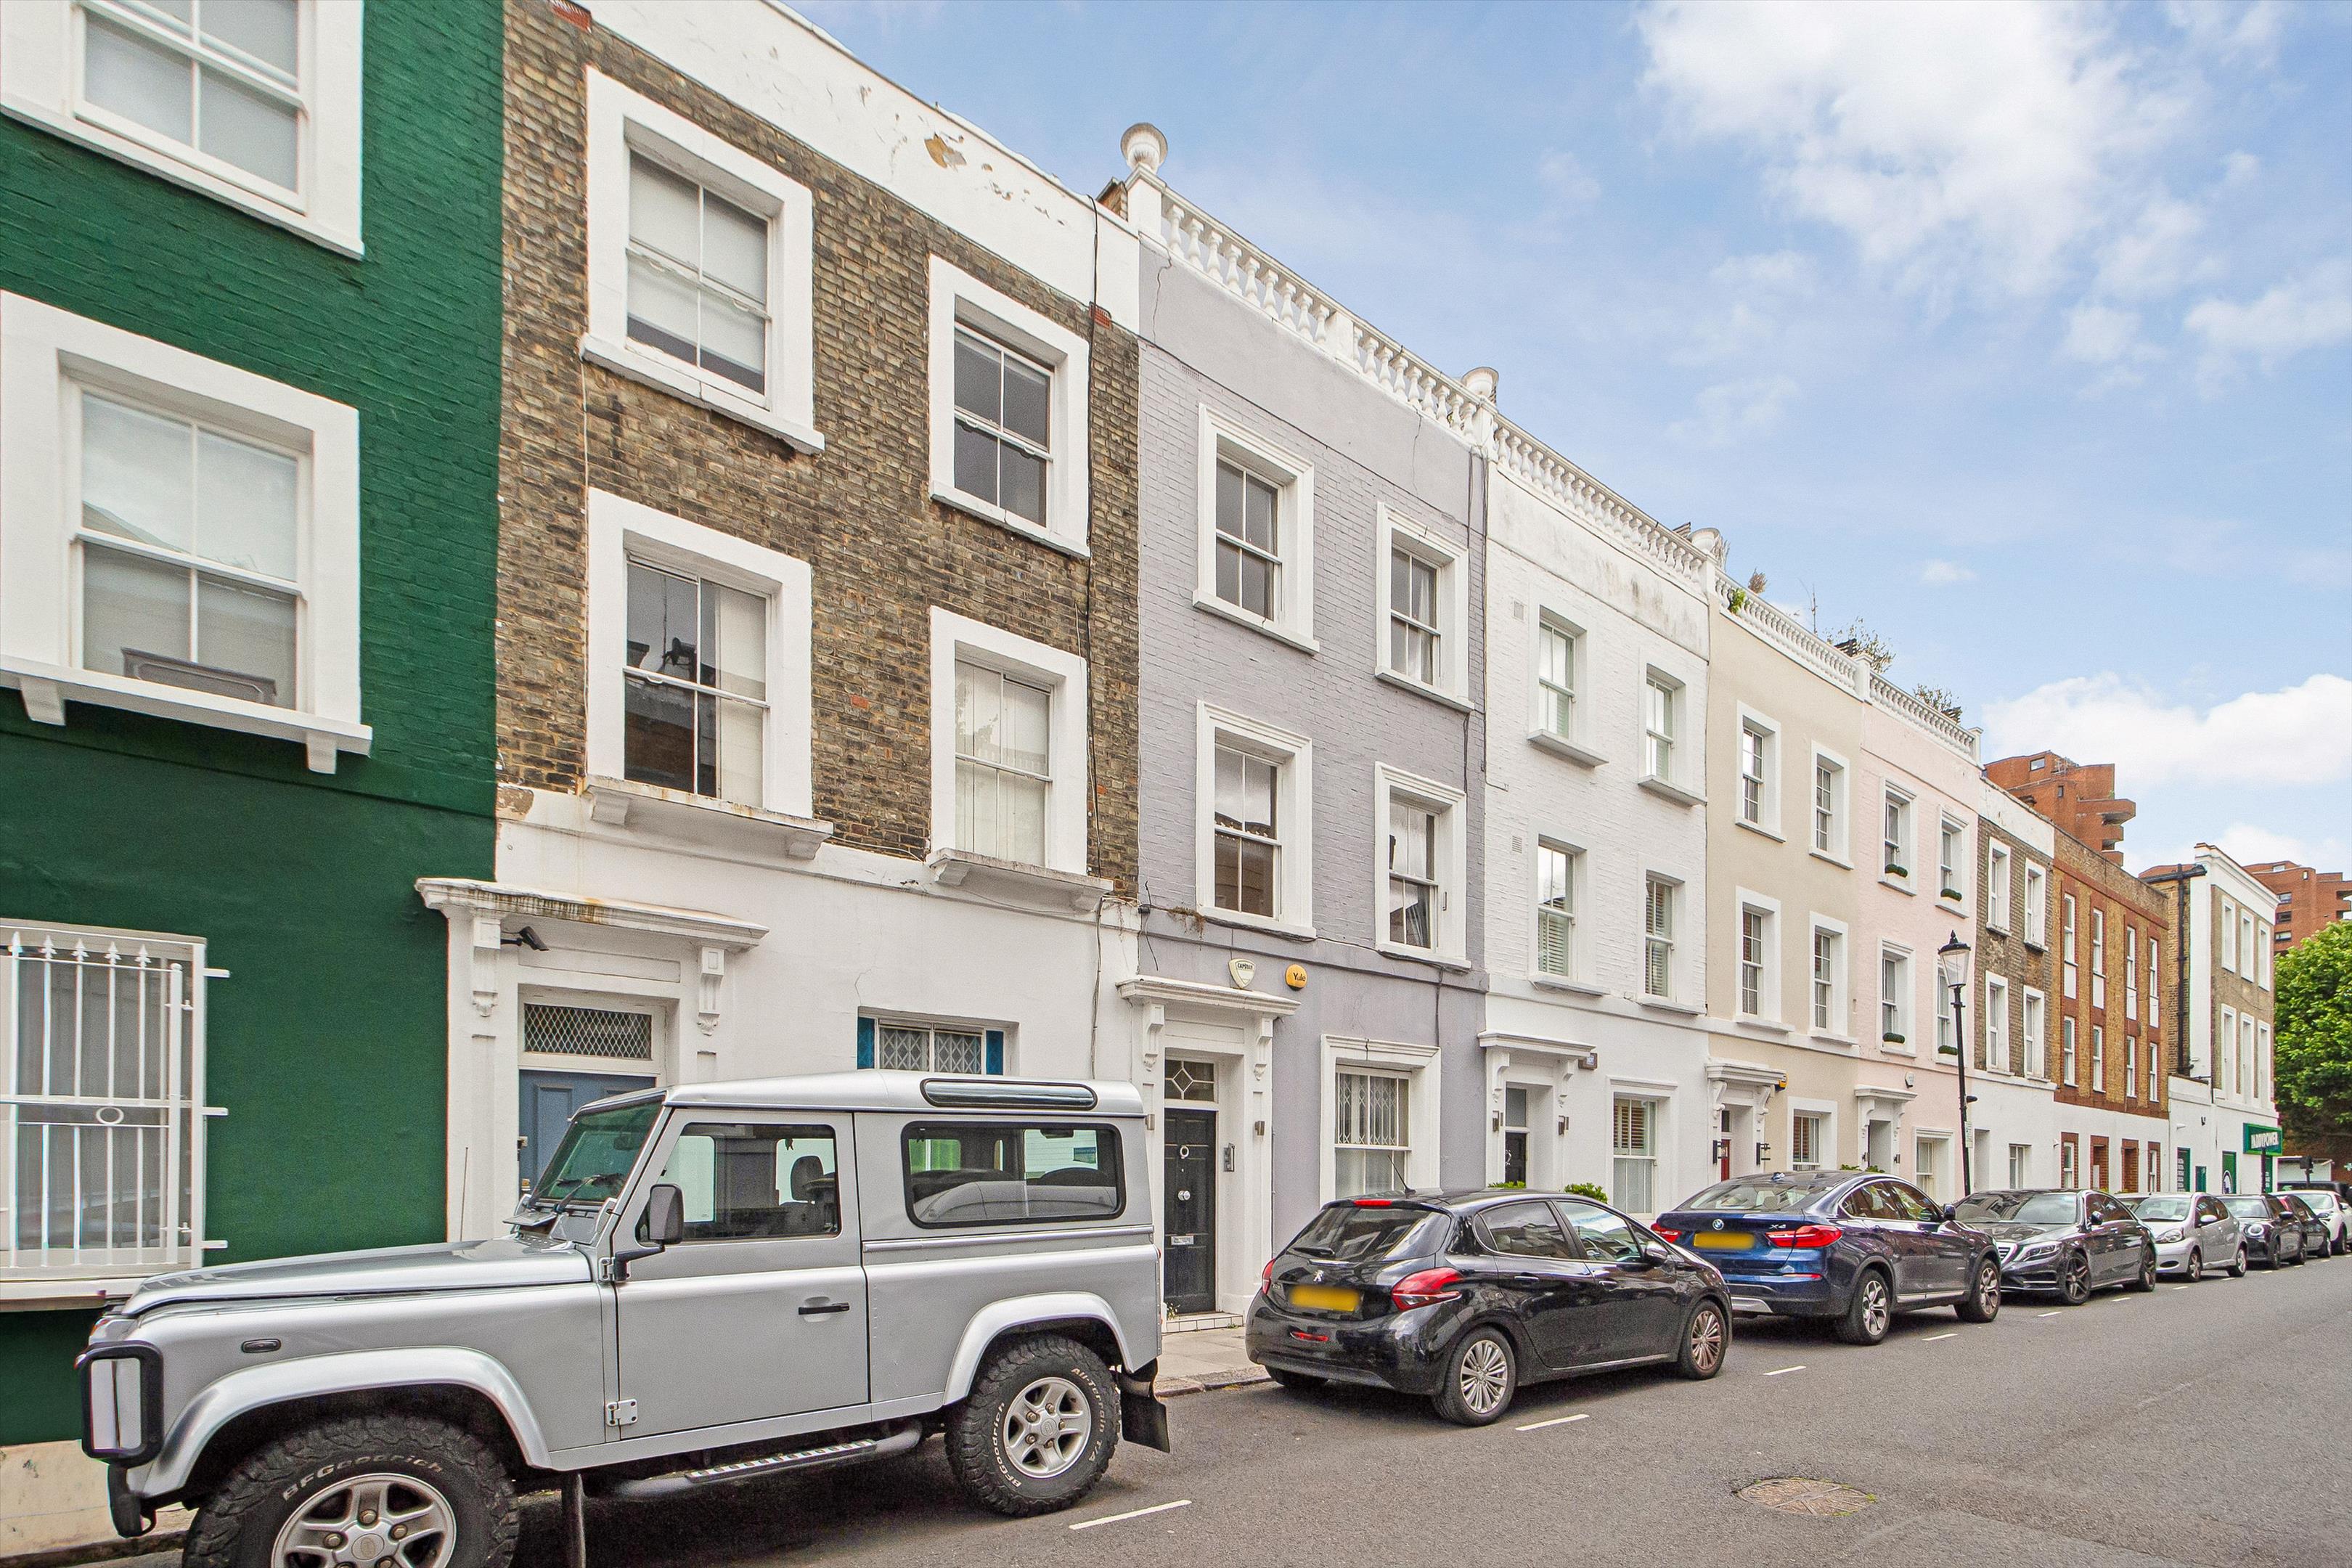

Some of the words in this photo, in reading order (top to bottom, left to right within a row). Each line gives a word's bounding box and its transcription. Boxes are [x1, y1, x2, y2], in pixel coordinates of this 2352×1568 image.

[1293, 972, 1306, 982] Yale
[992, 1402, 1022, 1487] BFGoodrich
[282, 1455, 442, 1500] BFGoodrich
